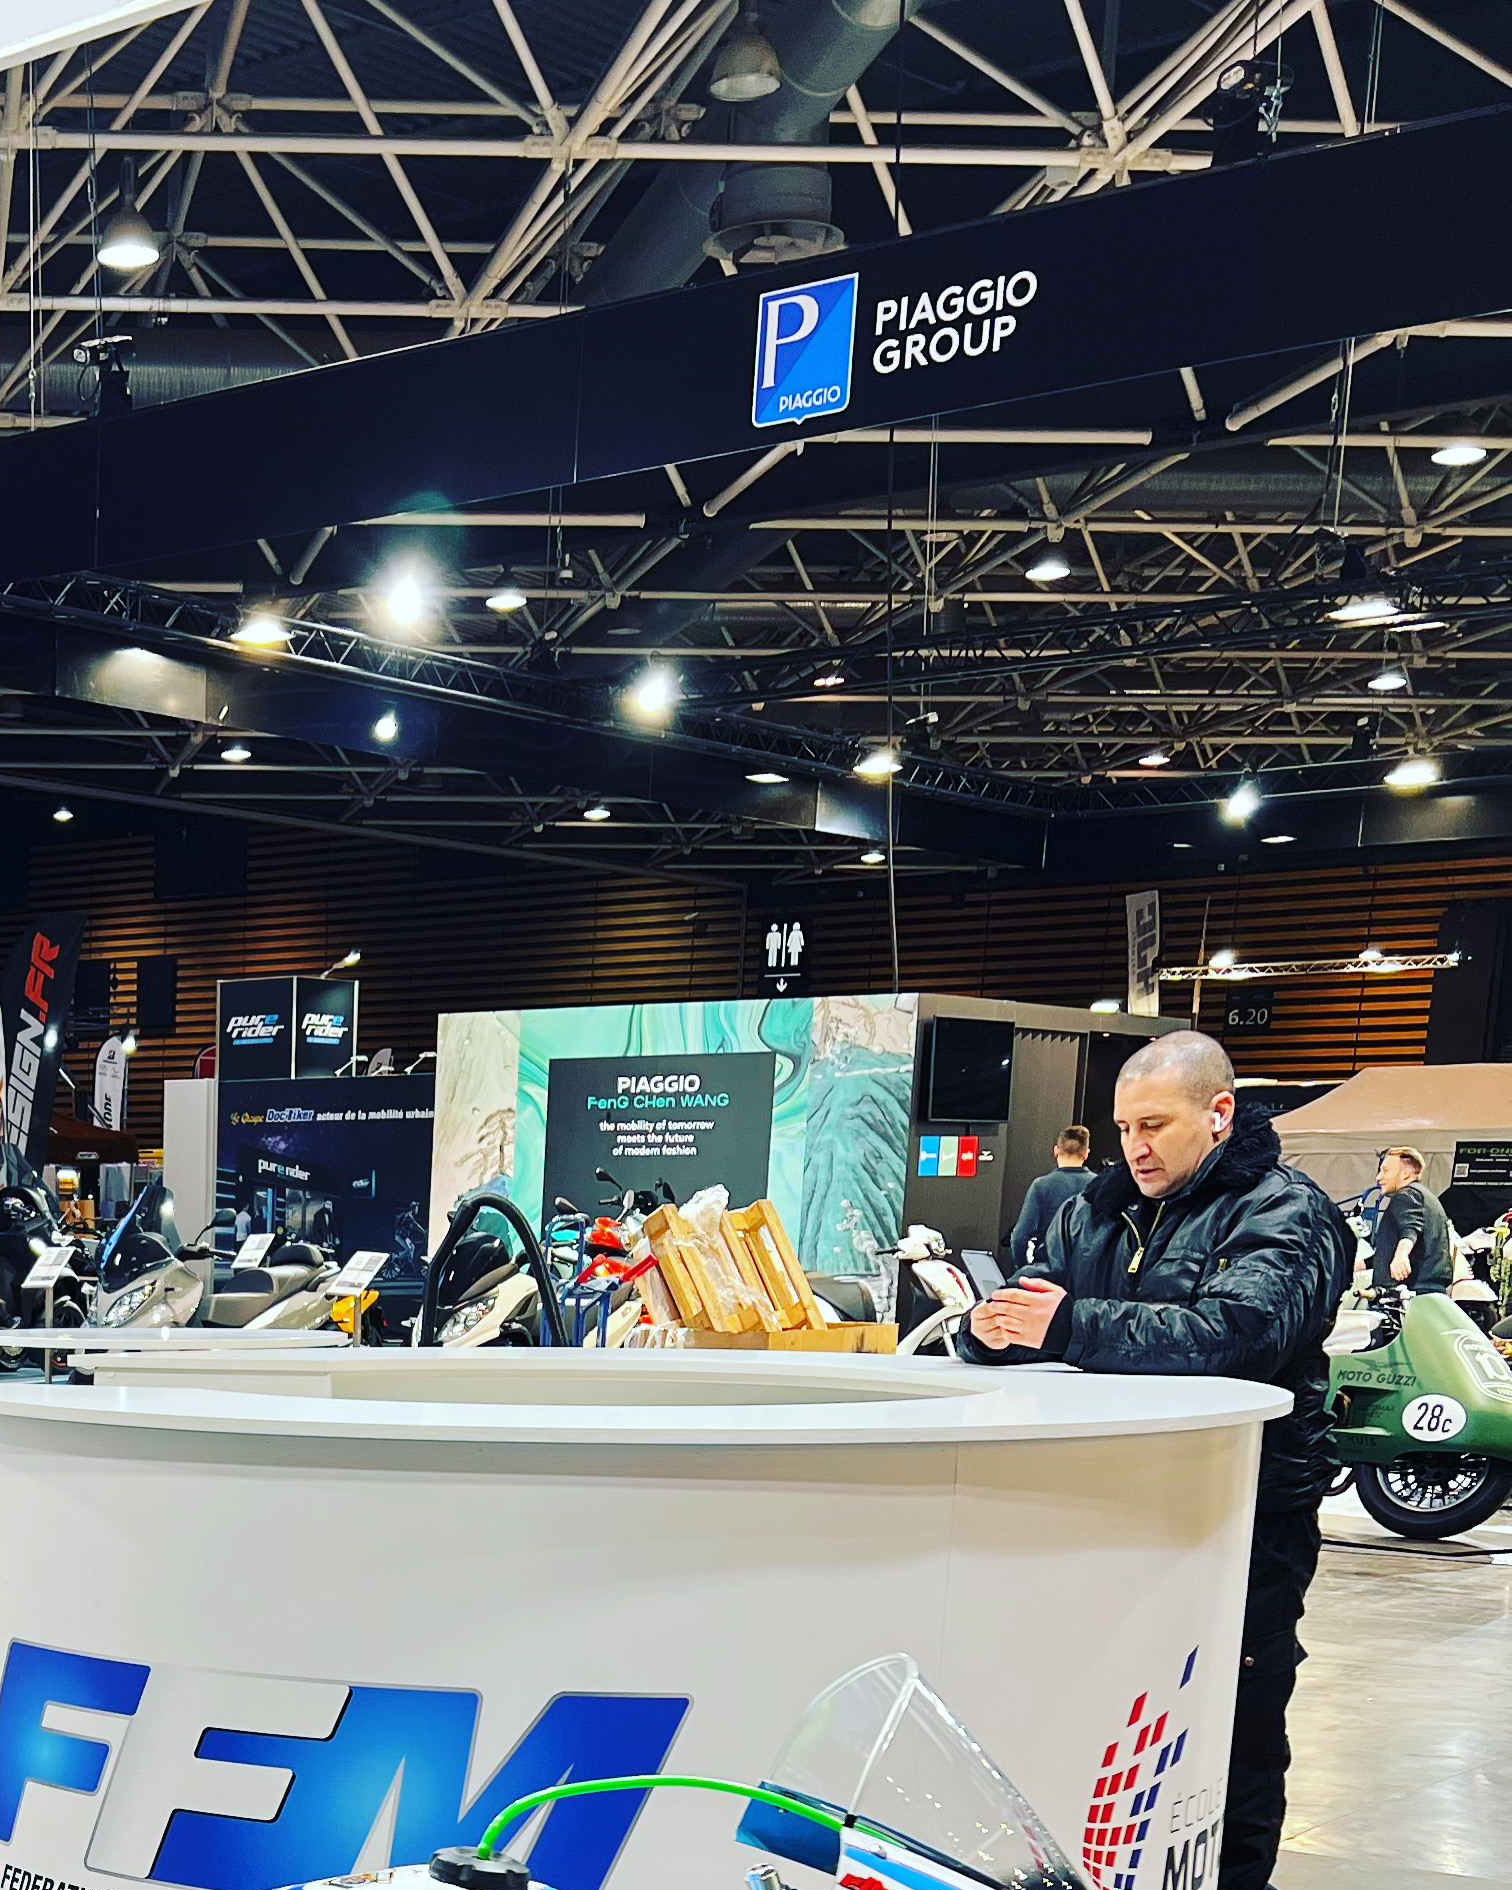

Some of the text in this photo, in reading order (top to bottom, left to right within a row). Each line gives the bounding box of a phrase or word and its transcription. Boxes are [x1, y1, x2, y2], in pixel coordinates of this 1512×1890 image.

[875, 270, 1038, 336] PIAGGIO
[872, 315, 1018, 374] GROUP
[779, 386, 841, 412] PIAGGIO
[226, 1013, 279, 1033] pure
[302, 1013, 345, 1029] pure
[1227, 1008, 1268, 1025] 6.20
[231, 1024, 285, 1039] rider
[305, 1023, 349, 1038] rider
[617, 1074, 701, 1094] PIAGGIO
[680, 1092, 730, 1108] WANG
[599, 1119, 715, 1133] the mobility of tomorrow
[616, 1132, 695, 1144] meets the future
[612, 1144, 698, 1156] of modern fashion
[1337, 1369, 1417, 1387] MOTO GUZZI
